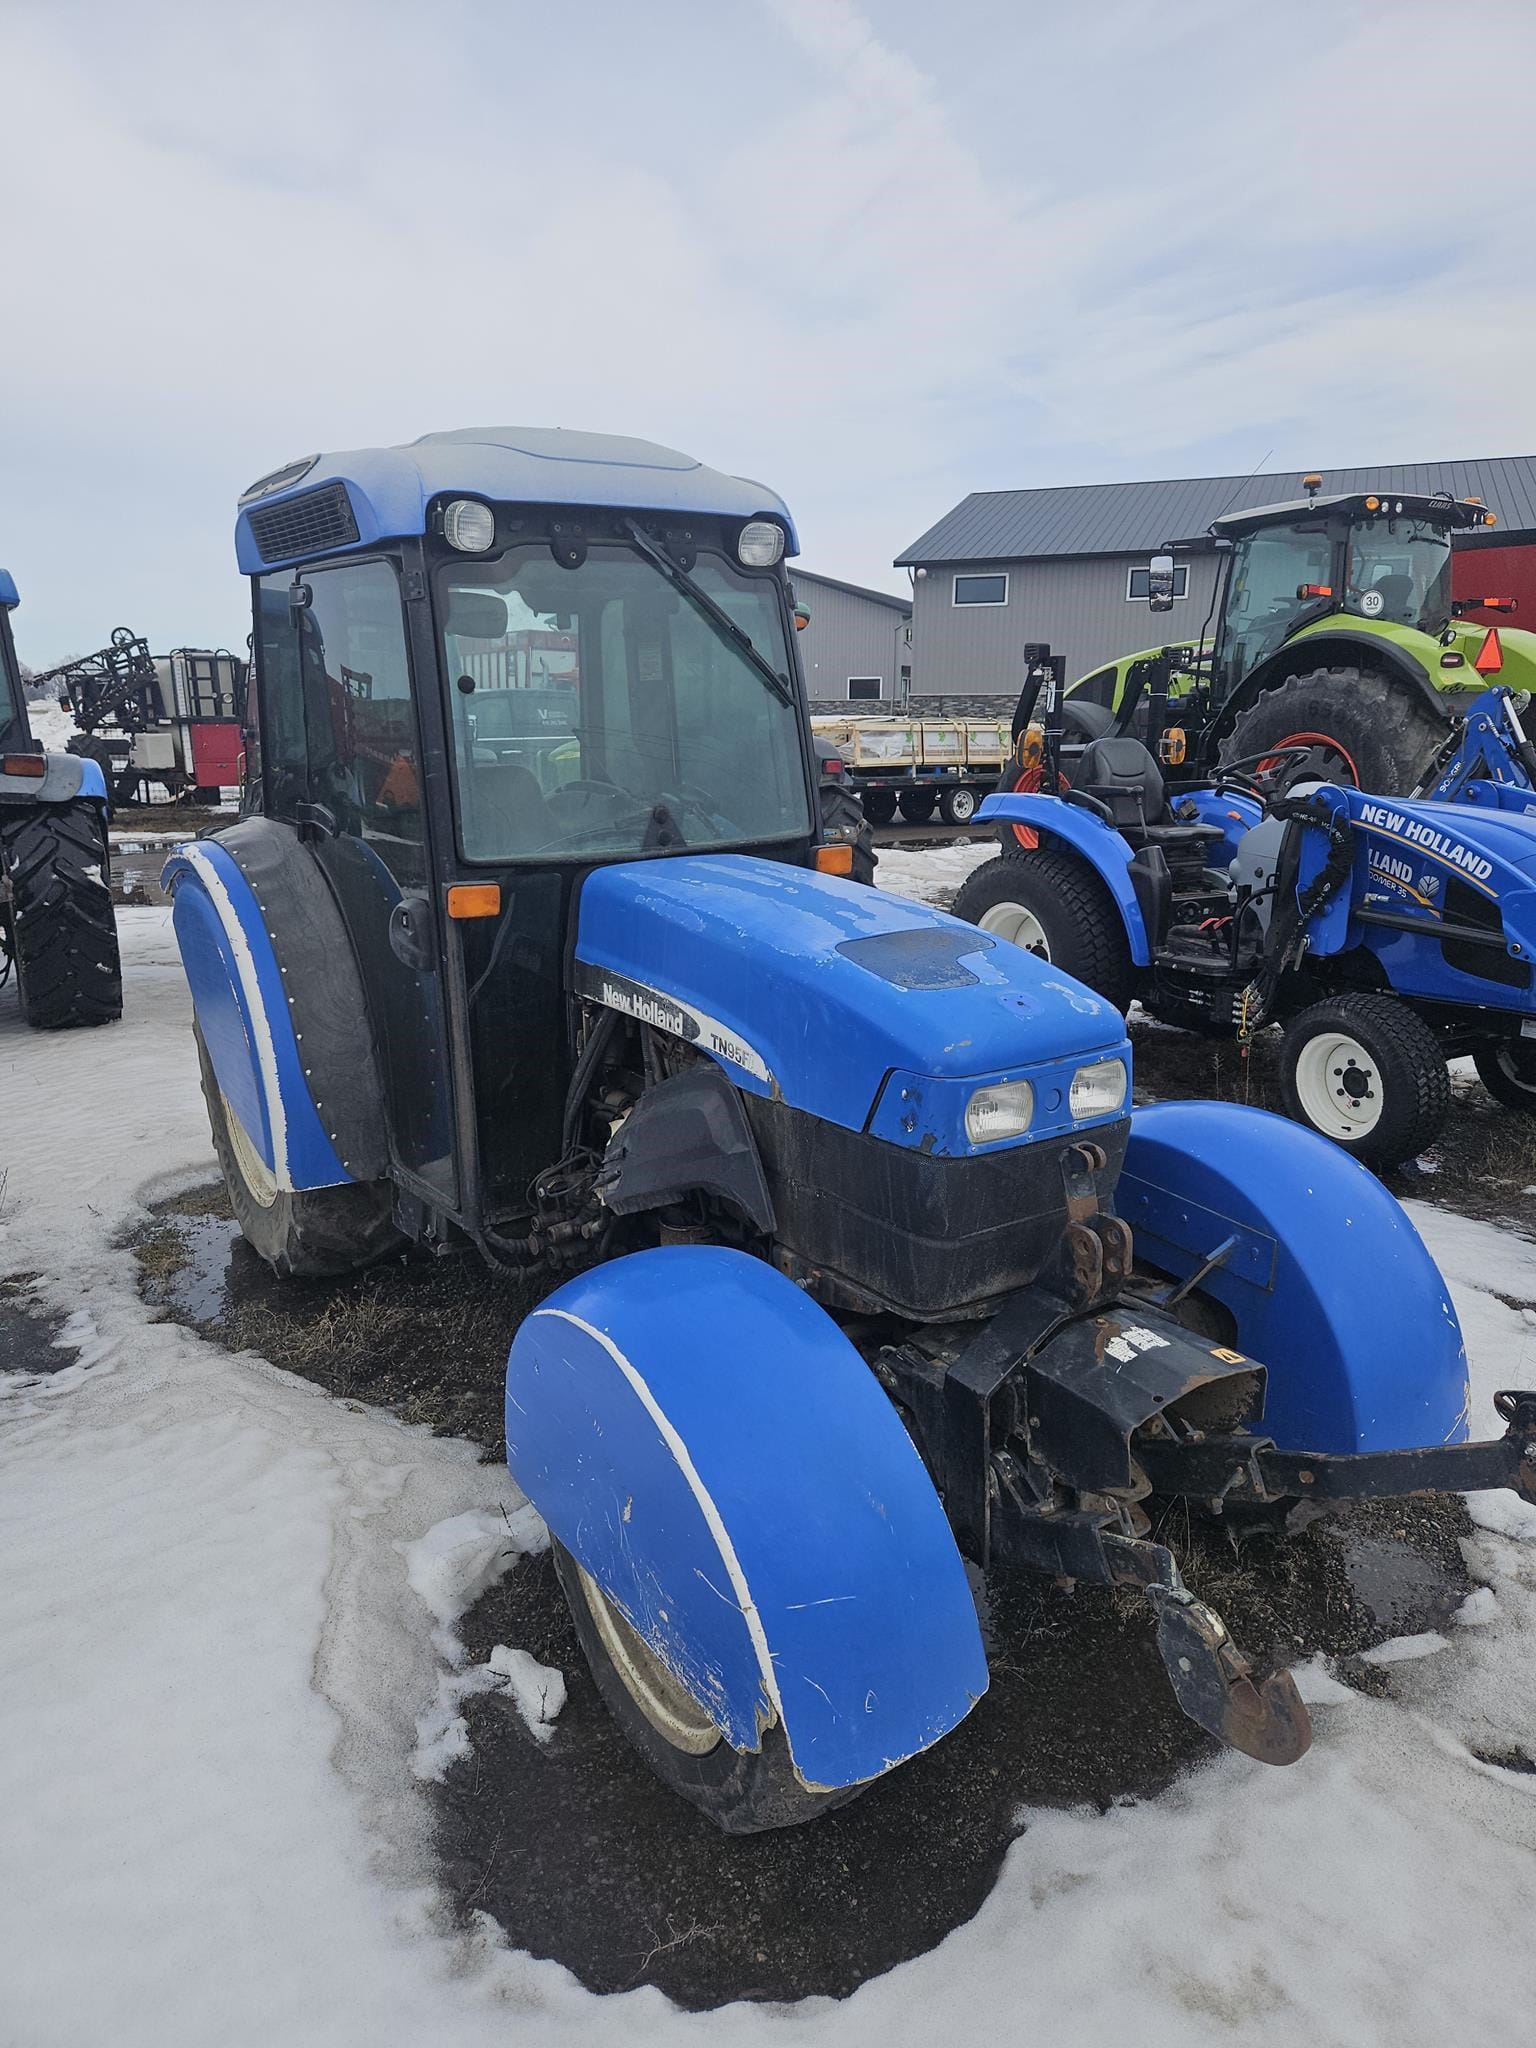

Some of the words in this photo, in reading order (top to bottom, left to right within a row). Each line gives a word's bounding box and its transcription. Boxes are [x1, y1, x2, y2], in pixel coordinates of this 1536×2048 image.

[1366, 596, 1379, 607] 30
[1360, 803, 1406, 833] NEW
[1405, 821, 1493, 880] HOLLAND
[1397, 885, 1408, 898] 35
[603, 982, 631, 1012] New
[632, 993, 684, 1035] Holland
[710, 1032, 755, 1068] TN95F
